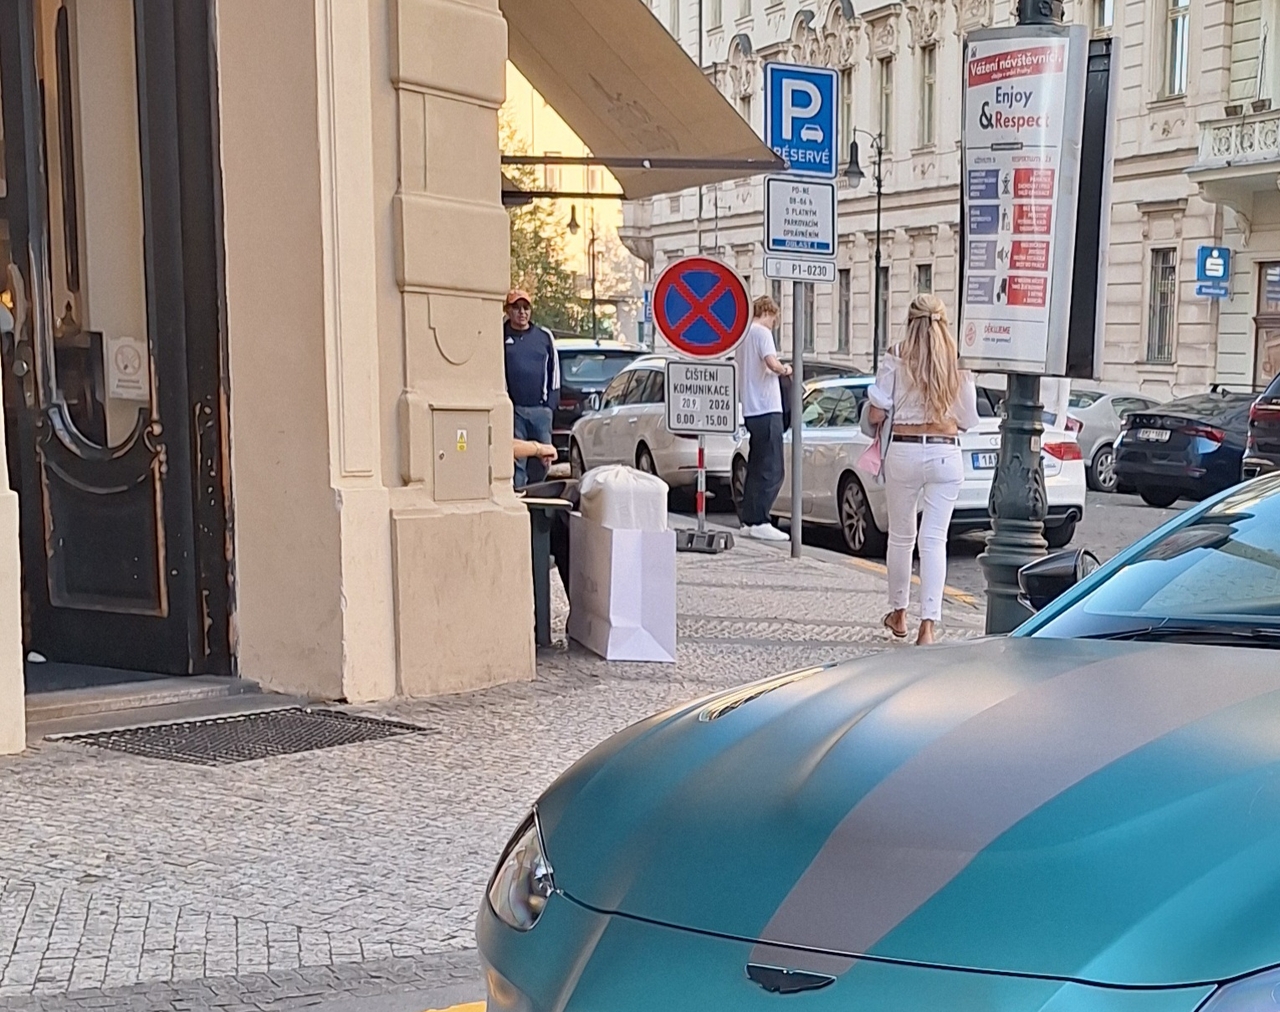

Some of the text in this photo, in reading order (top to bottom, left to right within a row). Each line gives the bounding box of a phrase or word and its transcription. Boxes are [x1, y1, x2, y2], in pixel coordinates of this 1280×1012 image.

[970, 57, 998, 77] Vážení
[995, 85, 1033, 109] Enjoy
[782, 77, 822, 140] P
[792, 263, 827, 277] P1-0230
[685, 367, 719, 382] ČIŠTĚNÍ
[673, 383, 730, 396] KOMUNIKACE
[709, 399, 730, 411] 2026
